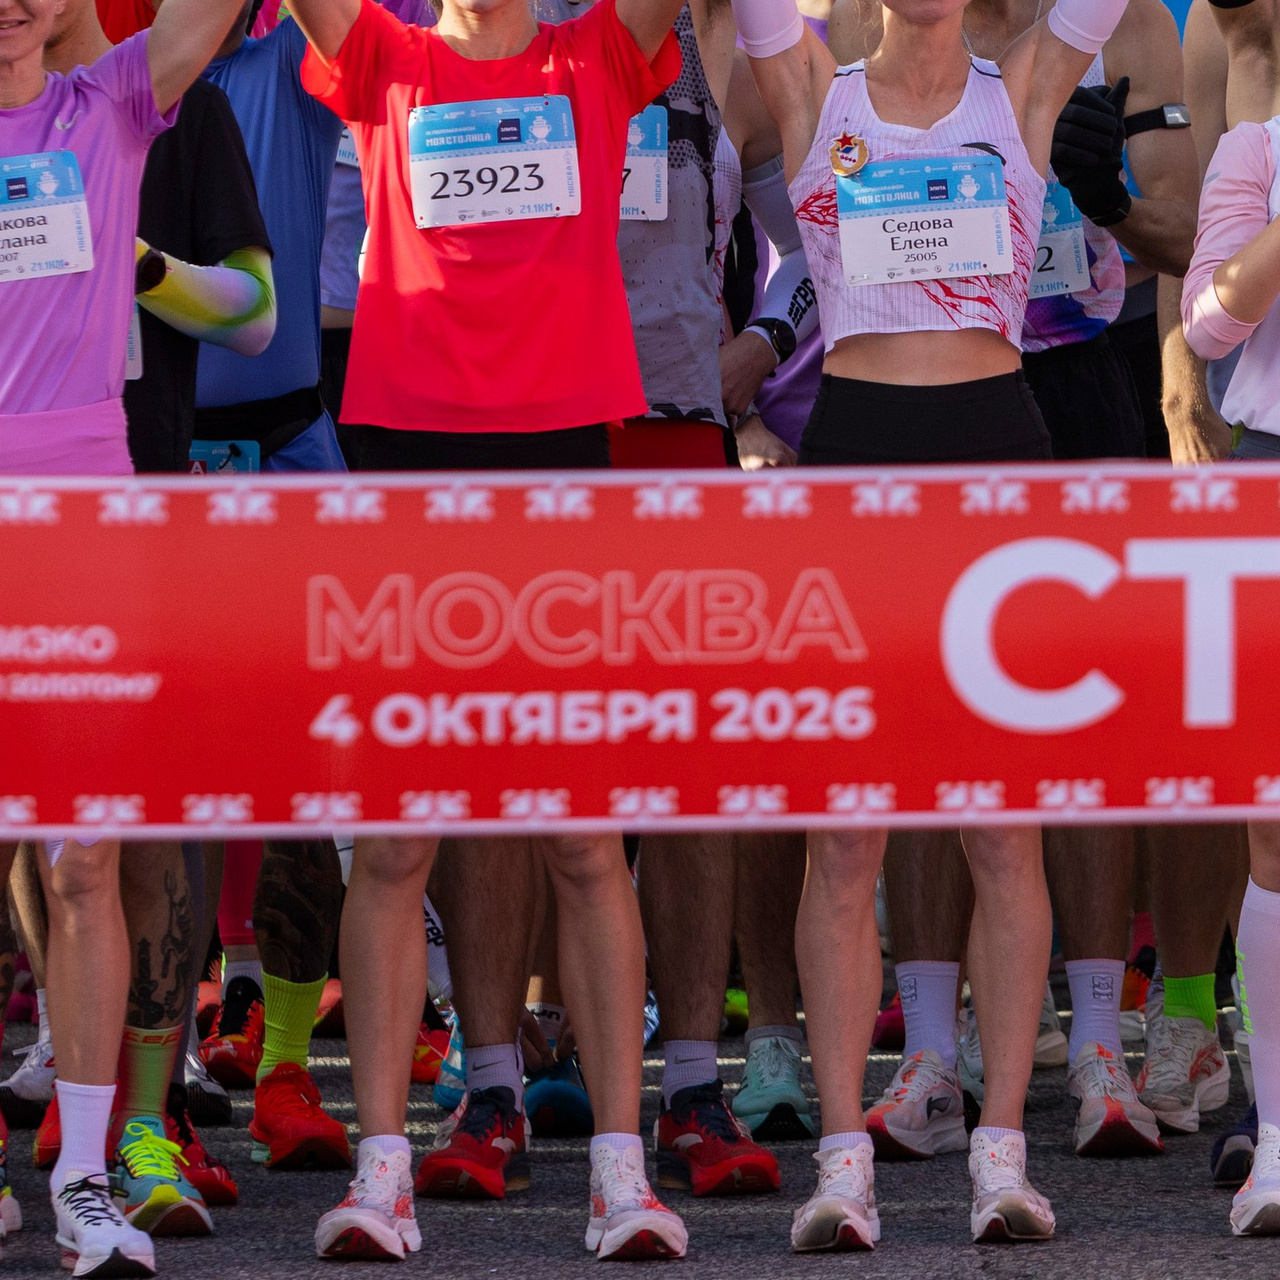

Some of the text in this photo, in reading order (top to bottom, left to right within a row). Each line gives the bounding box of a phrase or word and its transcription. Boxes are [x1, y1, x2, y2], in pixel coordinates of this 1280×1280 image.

[426, 133, 491, 147] МОЯ СТОЛИЦА
[429, 163, 545, 200] 23923
[854, 191, 920, 206] МОЯ СТОЛИЦА
[519, 203, 554, 215] 21.1КМ
[882, 218, 953, 234] Седова
[890, 236, 949, 251] Елена
[904, 252, 938, 263] 25005
[948, 261, 982, 273] 21.1КМ
[305, 568, 869, 670] МОСКВА
[309, 686, 876, 747] 4 ОКТЯБРЯ 2026
